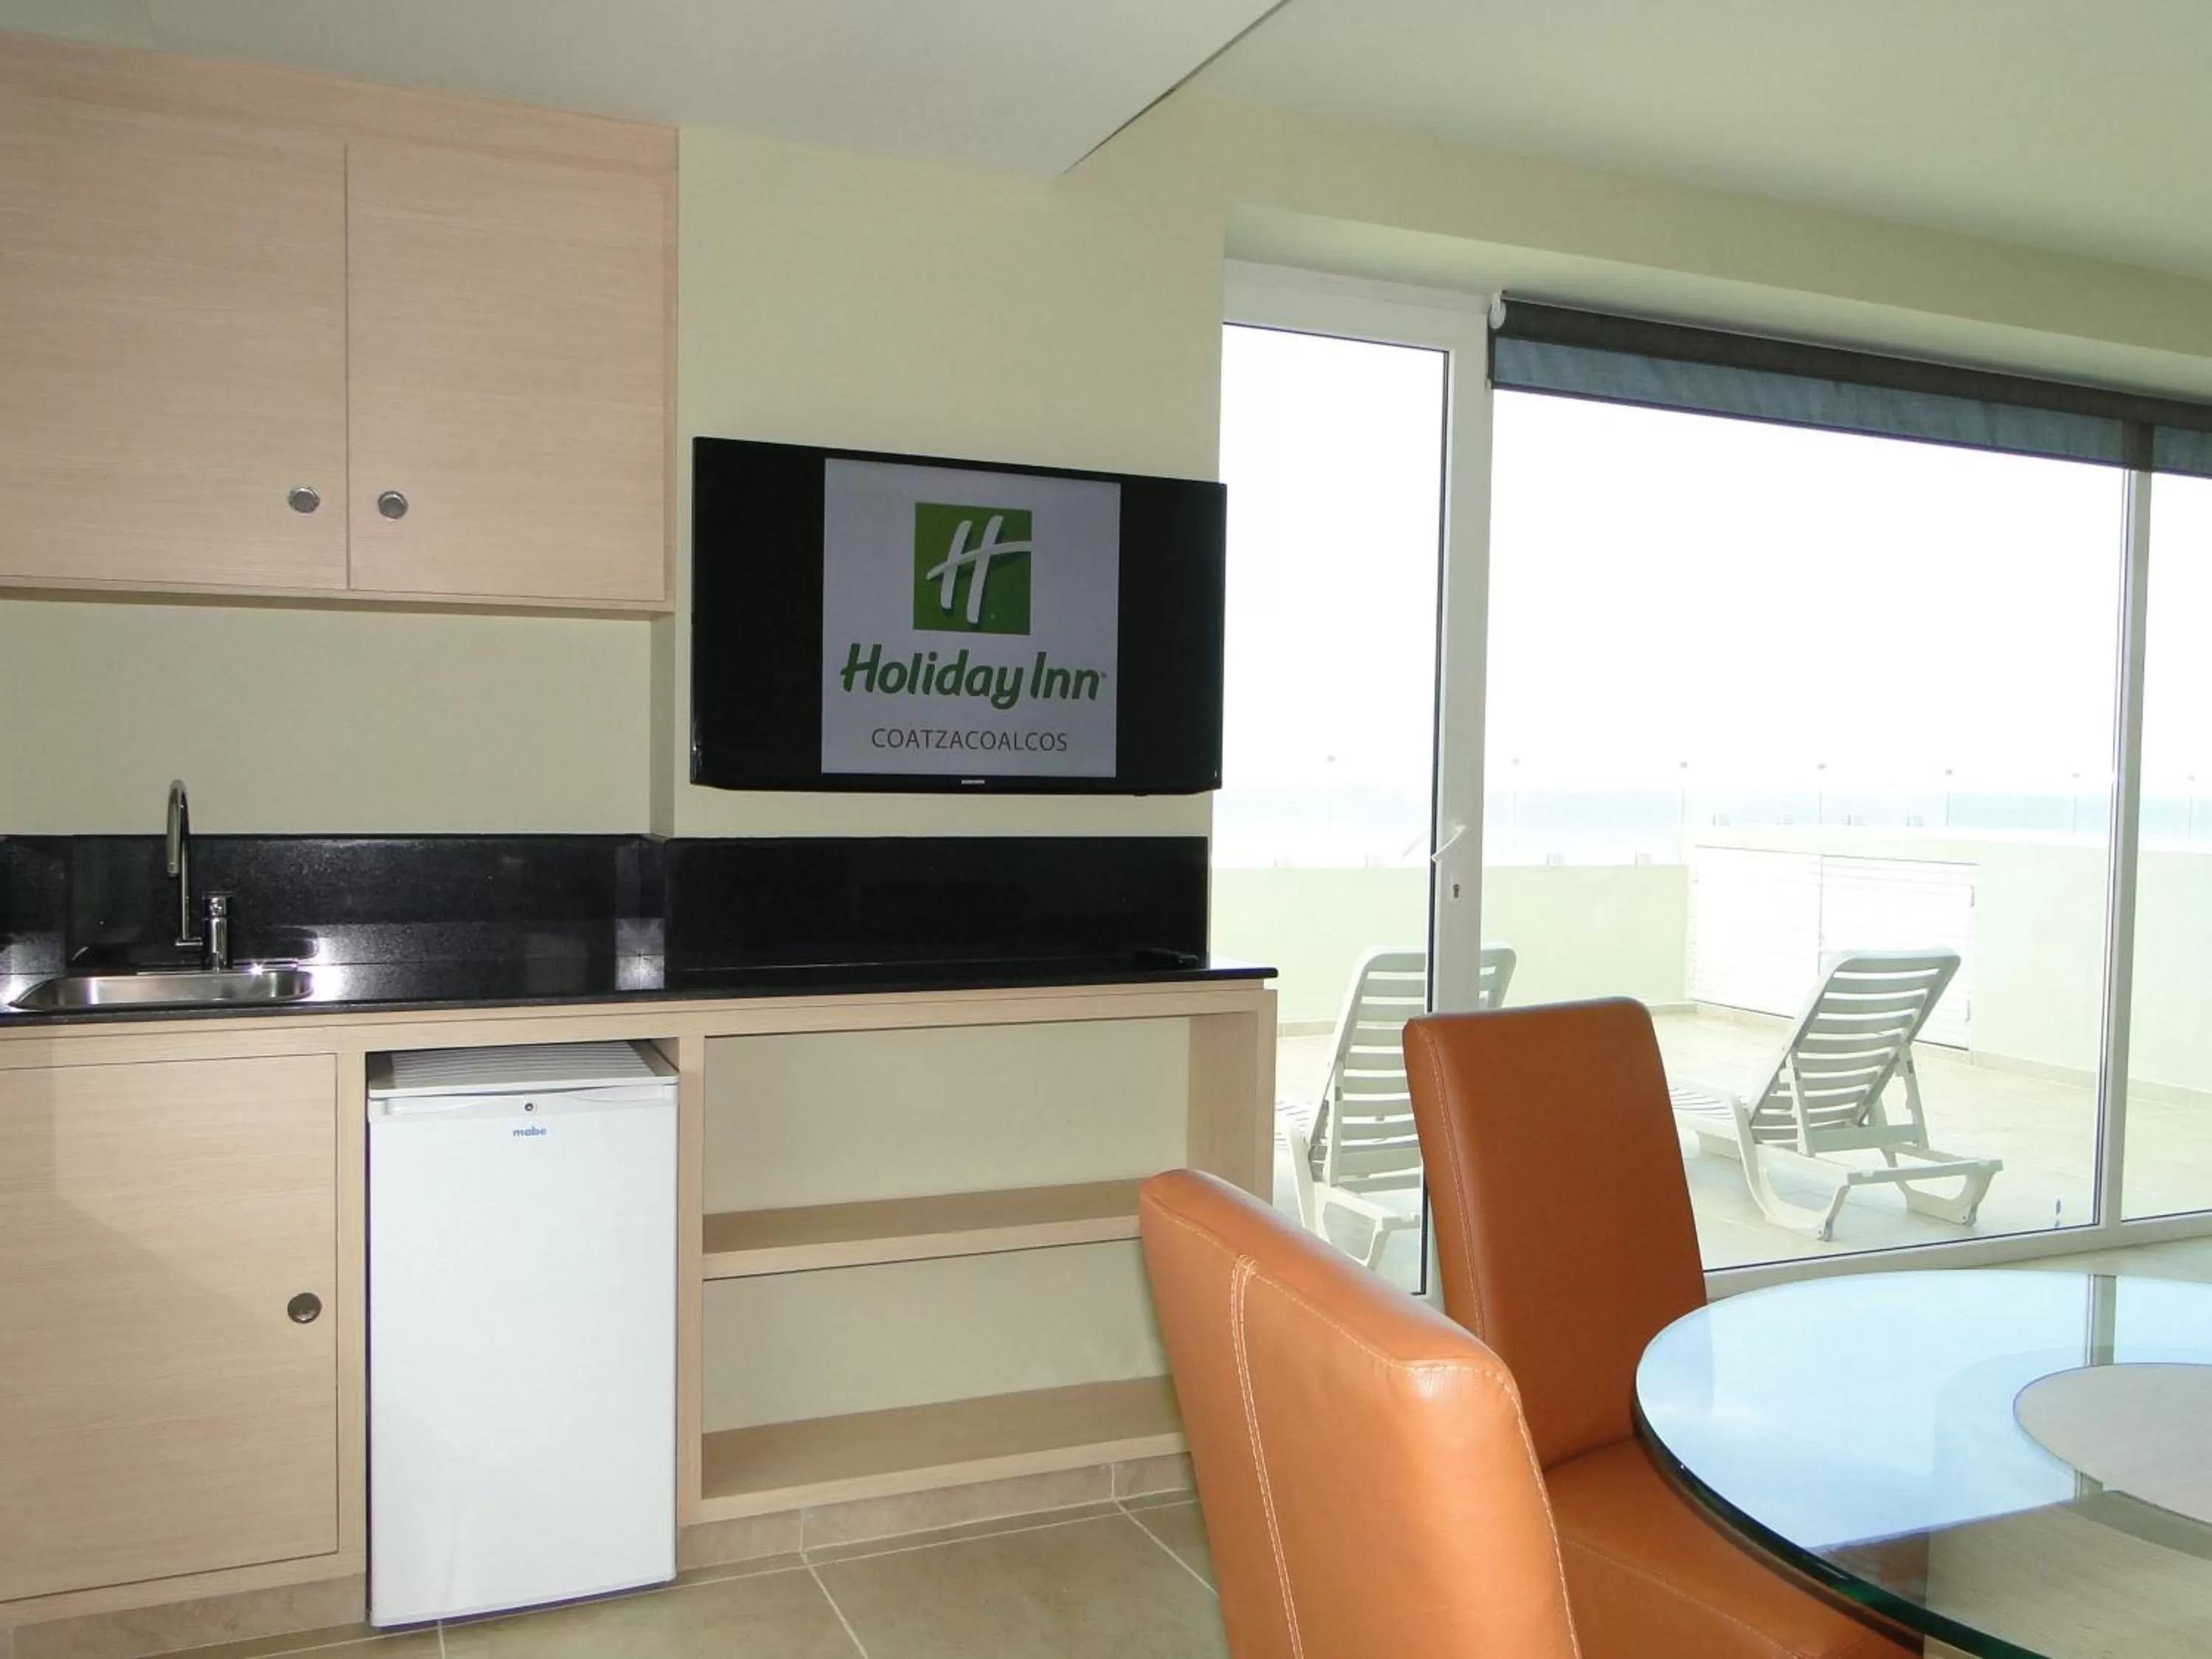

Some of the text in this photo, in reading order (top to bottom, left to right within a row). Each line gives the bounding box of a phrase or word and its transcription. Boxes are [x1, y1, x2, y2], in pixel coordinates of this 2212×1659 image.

[926, 514, 1032, 625] H
[840, 643, 1101, 709] Holiday Inn
[872, 728, 1068, 752] COATZACOALCOS
[512, 1125, 546, 1136] mabe
